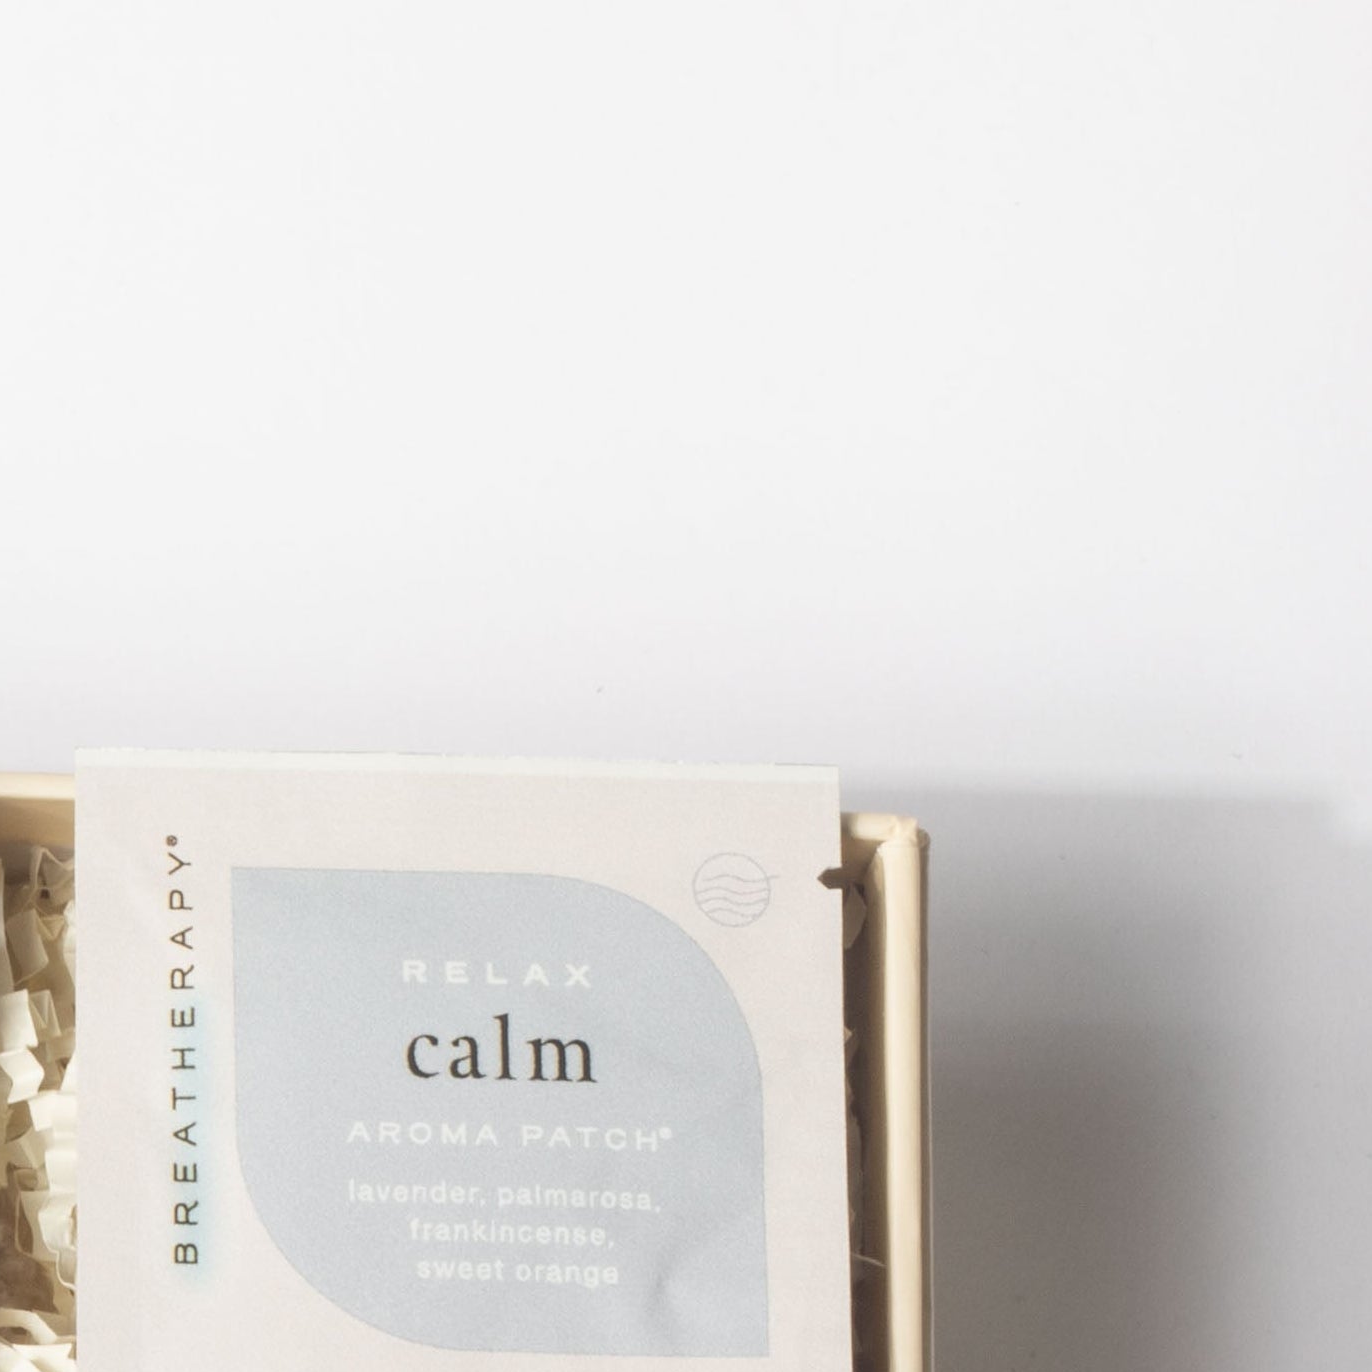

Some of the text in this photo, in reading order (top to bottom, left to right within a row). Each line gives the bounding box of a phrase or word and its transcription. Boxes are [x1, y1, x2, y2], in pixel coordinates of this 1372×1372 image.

[402, 960, 591, 987] RELAX
[406, 1014, 597, 1084] calm
[347, 1122, 497, 1147] AROMA
[348, 1180, 660, 1212] lavender, palmarosa,
[410, 1218, 613, 1248] frankincense,
[417, 1259, 618, 1288] sweet orange
